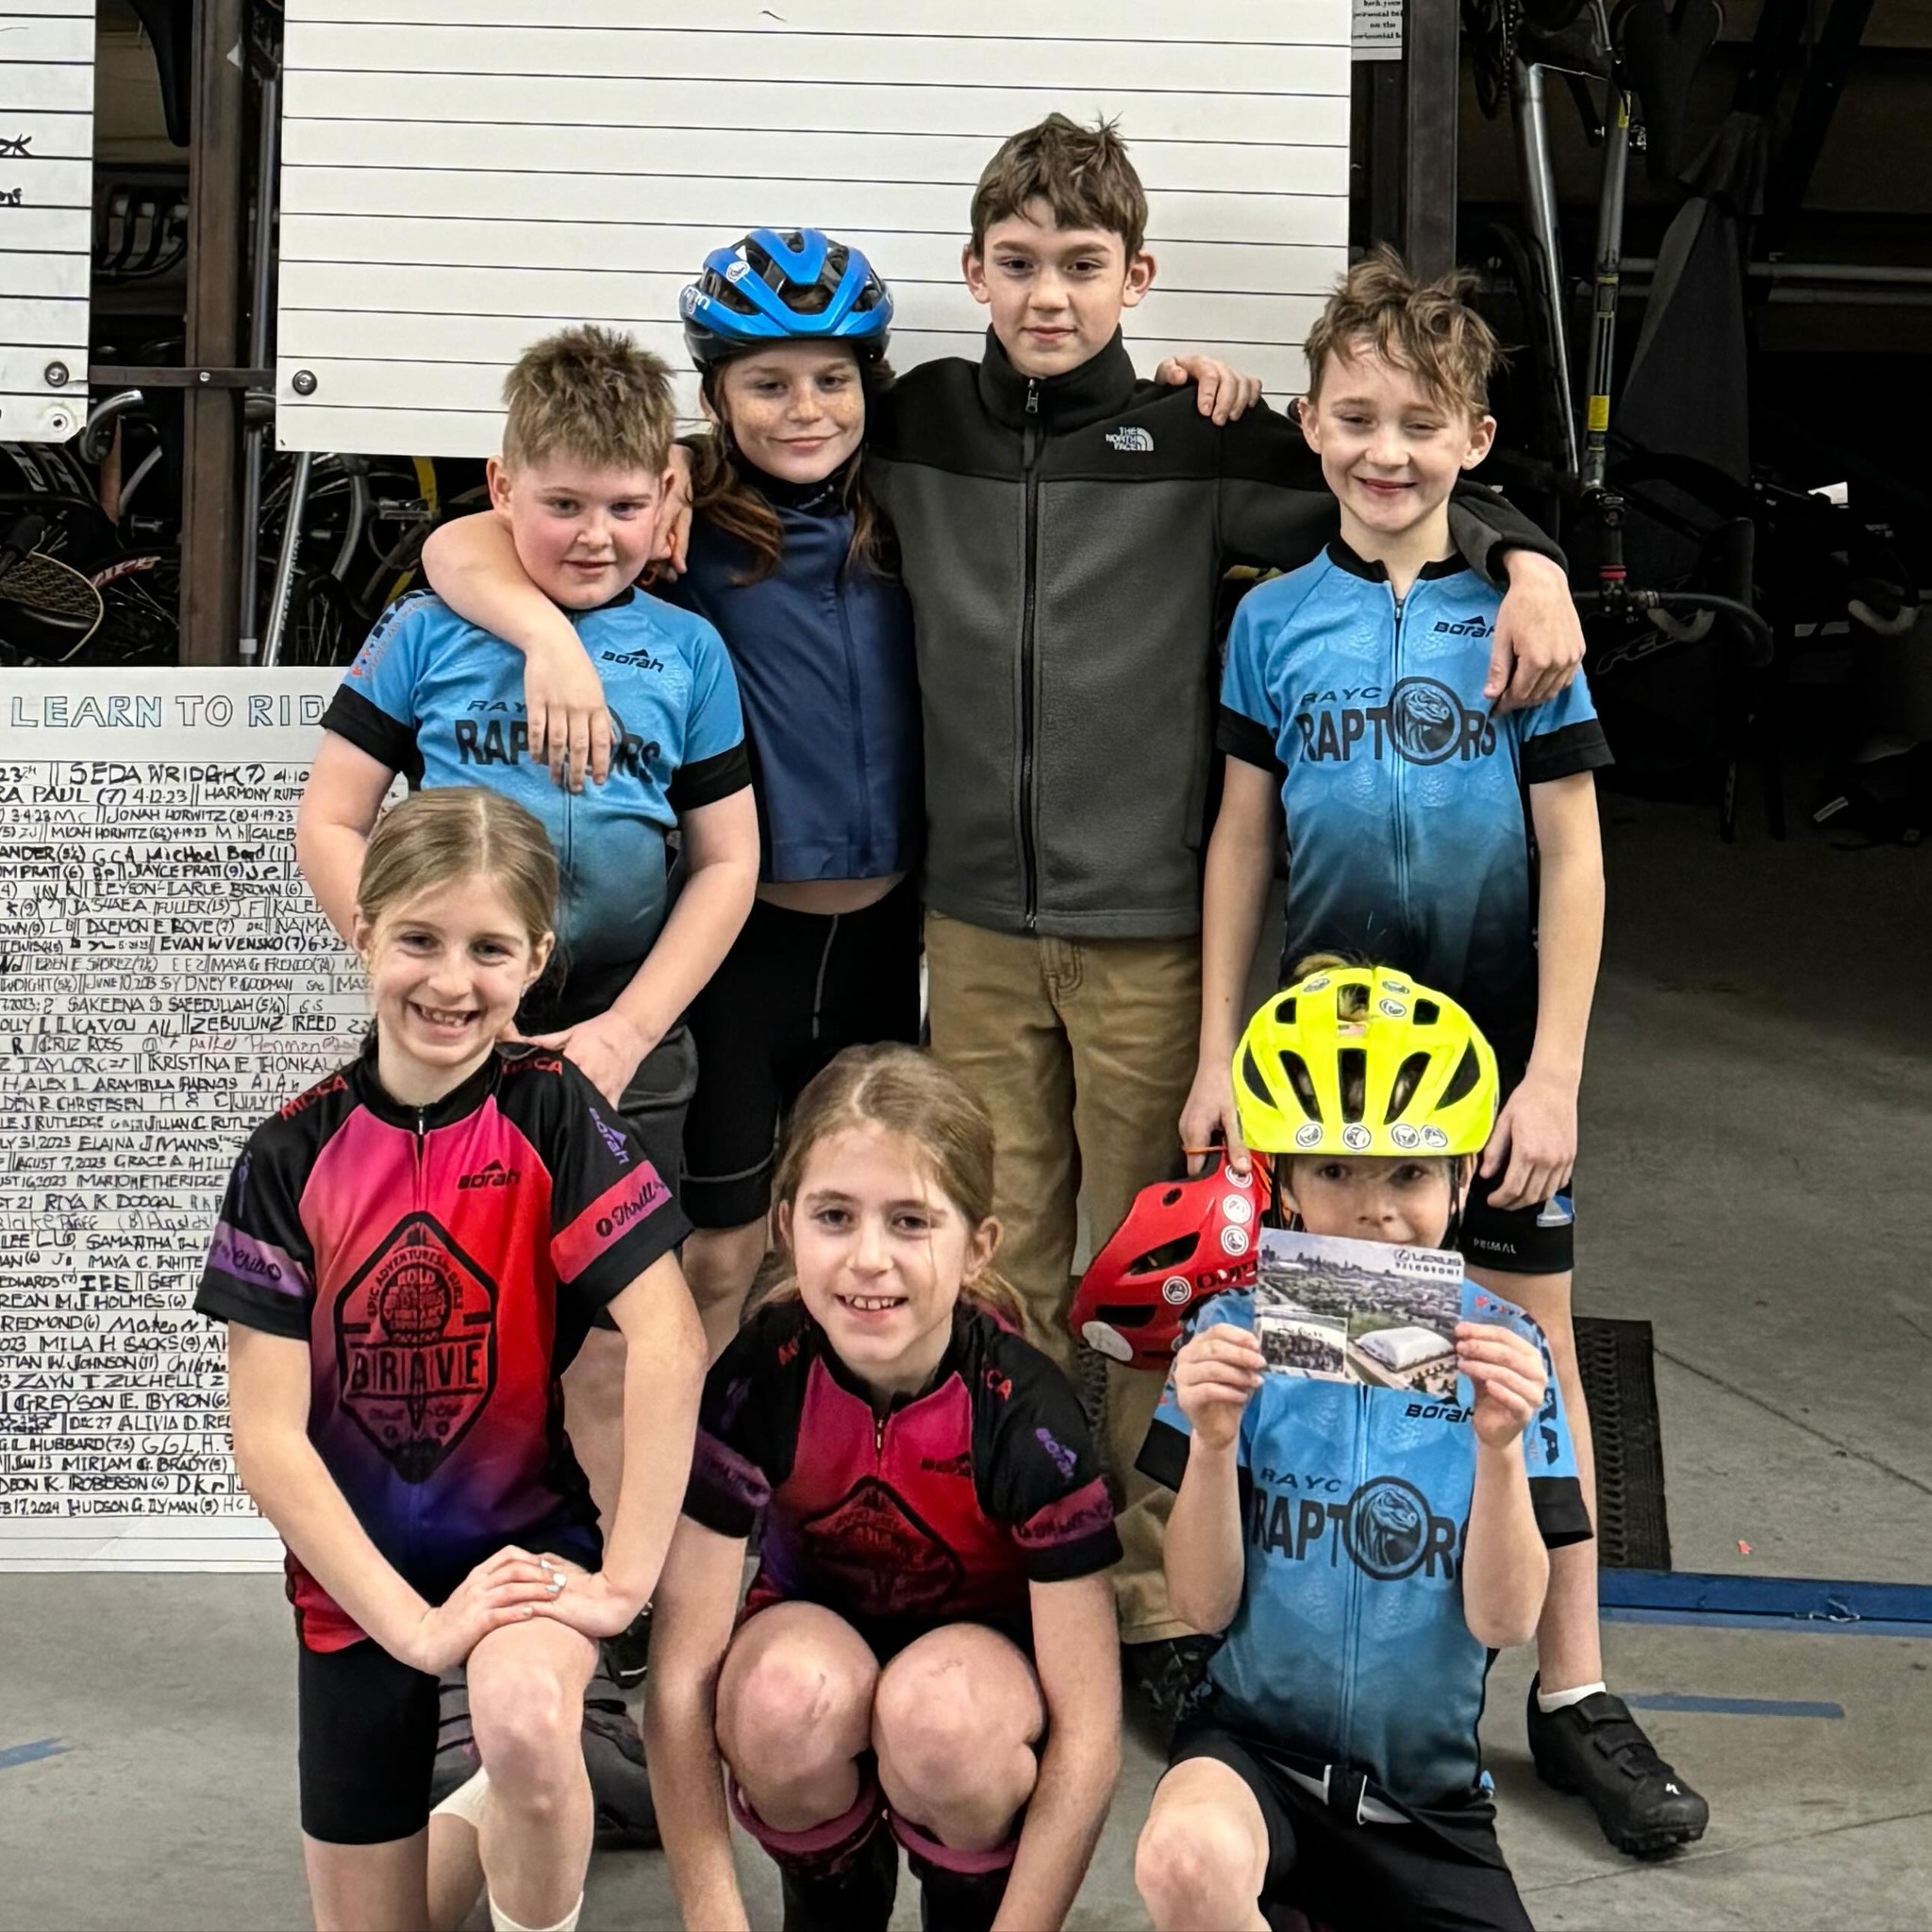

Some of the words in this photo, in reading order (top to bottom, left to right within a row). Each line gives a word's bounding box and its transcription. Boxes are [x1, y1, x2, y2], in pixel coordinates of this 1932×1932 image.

[1106, 434, 1137, 443] NORTH
[1119, 426, 1137, 435] THE
[1301, 686, 1383, 707] RAYC
[10, 695, 162, 727] LEARN
[175, 695, 233, 726] TO
[70, 761, 142, 785] SEDA
[33, 786, 90, 803] PAUL
[205, 787, 273, 802] HARMONY
[107, 807, 159, 824] JONAH
[165, 808, 227, 822] HORWITZ
[95, 826, 147, 839] HORWITZ
[251, 826, 296, 841] CALEB
[183, 864, 222, 878] PRATT
[160, 936, 204, 952] EVAN
[77, 1135, 135, 1152] ELAINA
[89, 1254, 132, 1269] MAYA
[94, 1293, 166, 1309] HOLMES
[1, 1314, 83, 1333] REDMOND
[350, 1341, 483, 1392] BRAVE
[13, 1373, 75, 1390] ZAYN
[14, 1392, 115, 1414] GREYSON
[146, 1391, 210, 1410] BYRON
[117, 1414, 179, 1432] ALIVIA
[29, 1437, 105, 1453] HUBBARD
[61, 1456, 133, 1473] MIRIAM
[1260, 1466, 1342, 1493] RAYC
[67, 1498, 129, 1518] HUDSON
[1251, 1475, 1473, 1581] RAPTOR
